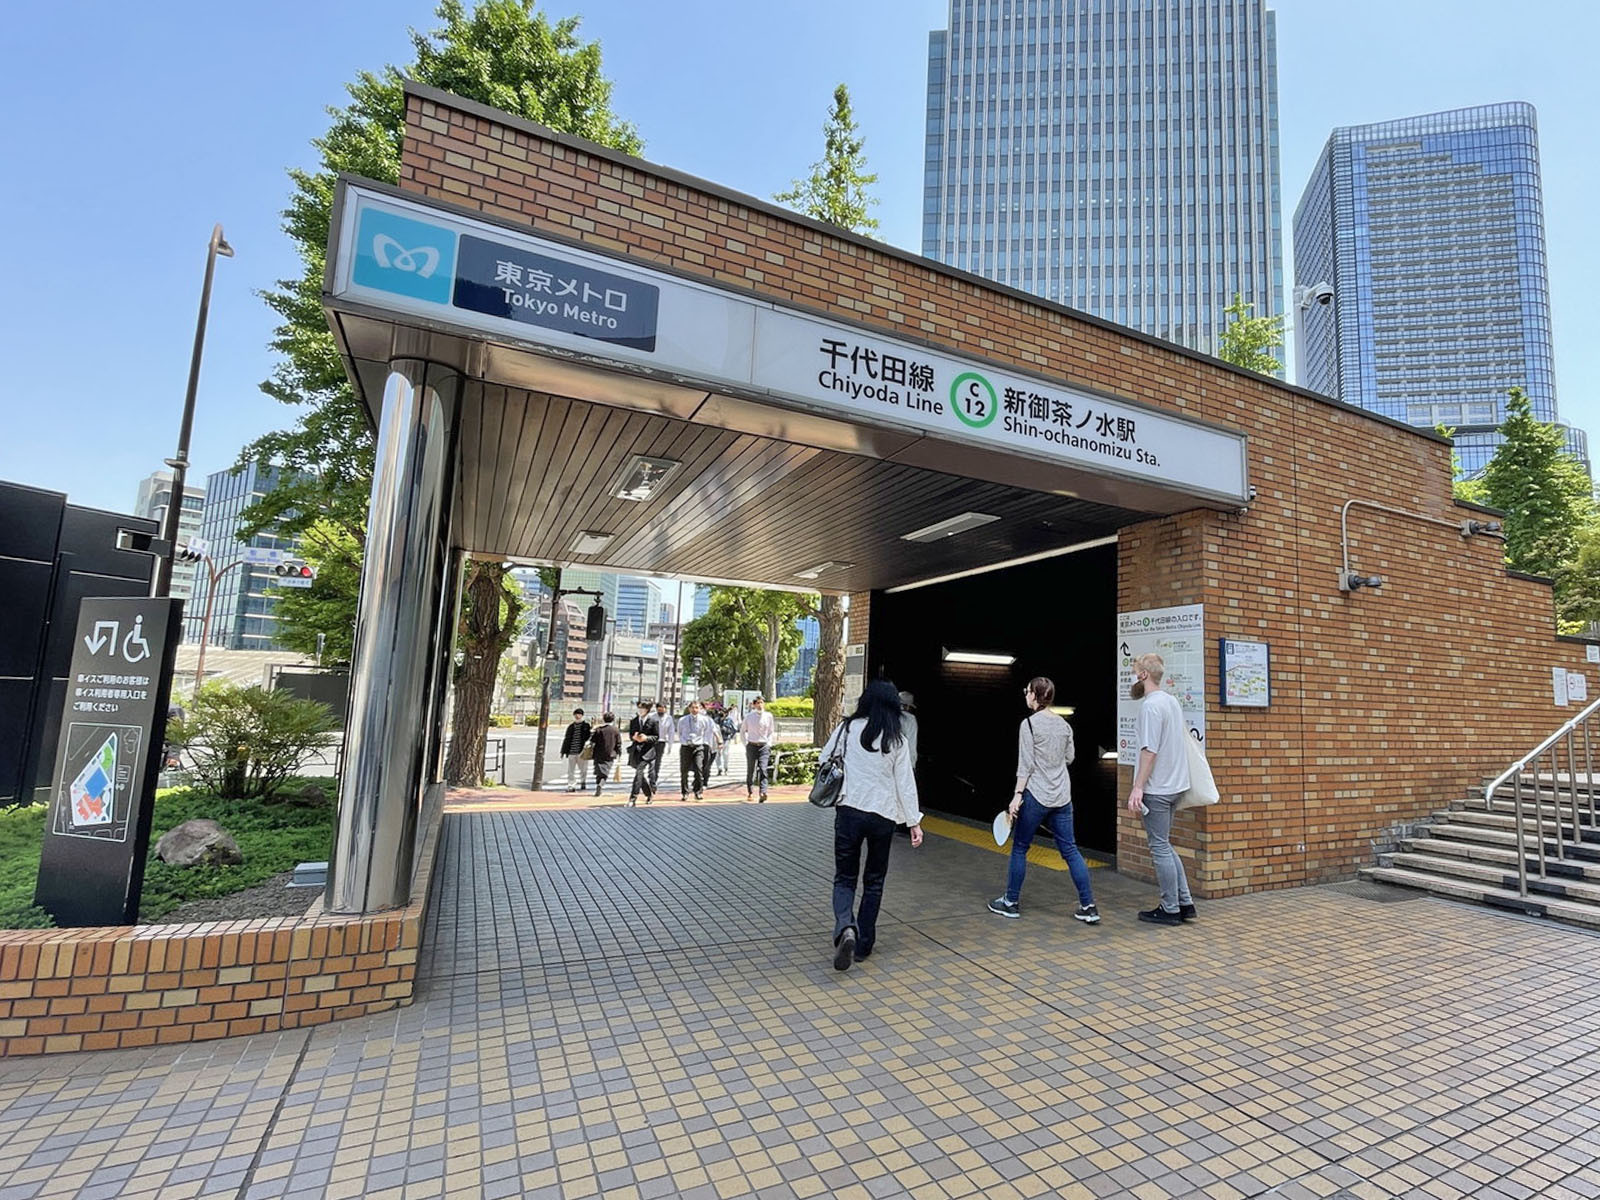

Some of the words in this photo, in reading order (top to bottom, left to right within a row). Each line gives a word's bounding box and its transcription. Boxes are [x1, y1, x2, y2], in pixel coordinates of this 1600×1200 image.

[494, 259, 627, 312] 東京メトロ
[502, 287, 558, 315] Tokyo
[563, 302, 617, 329] Metro
[819, 338, 935, 393] 千代田線
[969, 382, 980, 398] C
[818, 370, 899, 405] Chiyoda
[906, 391, 944, 415] Line
[964, 397, 985, 418] 12
[1003, 386, 1136, 445] 新御茶ノ水駅
[1003, 415, 1132, 461] Shin-ochanomizu
[1136, 448, 1161, 468] Sta.
